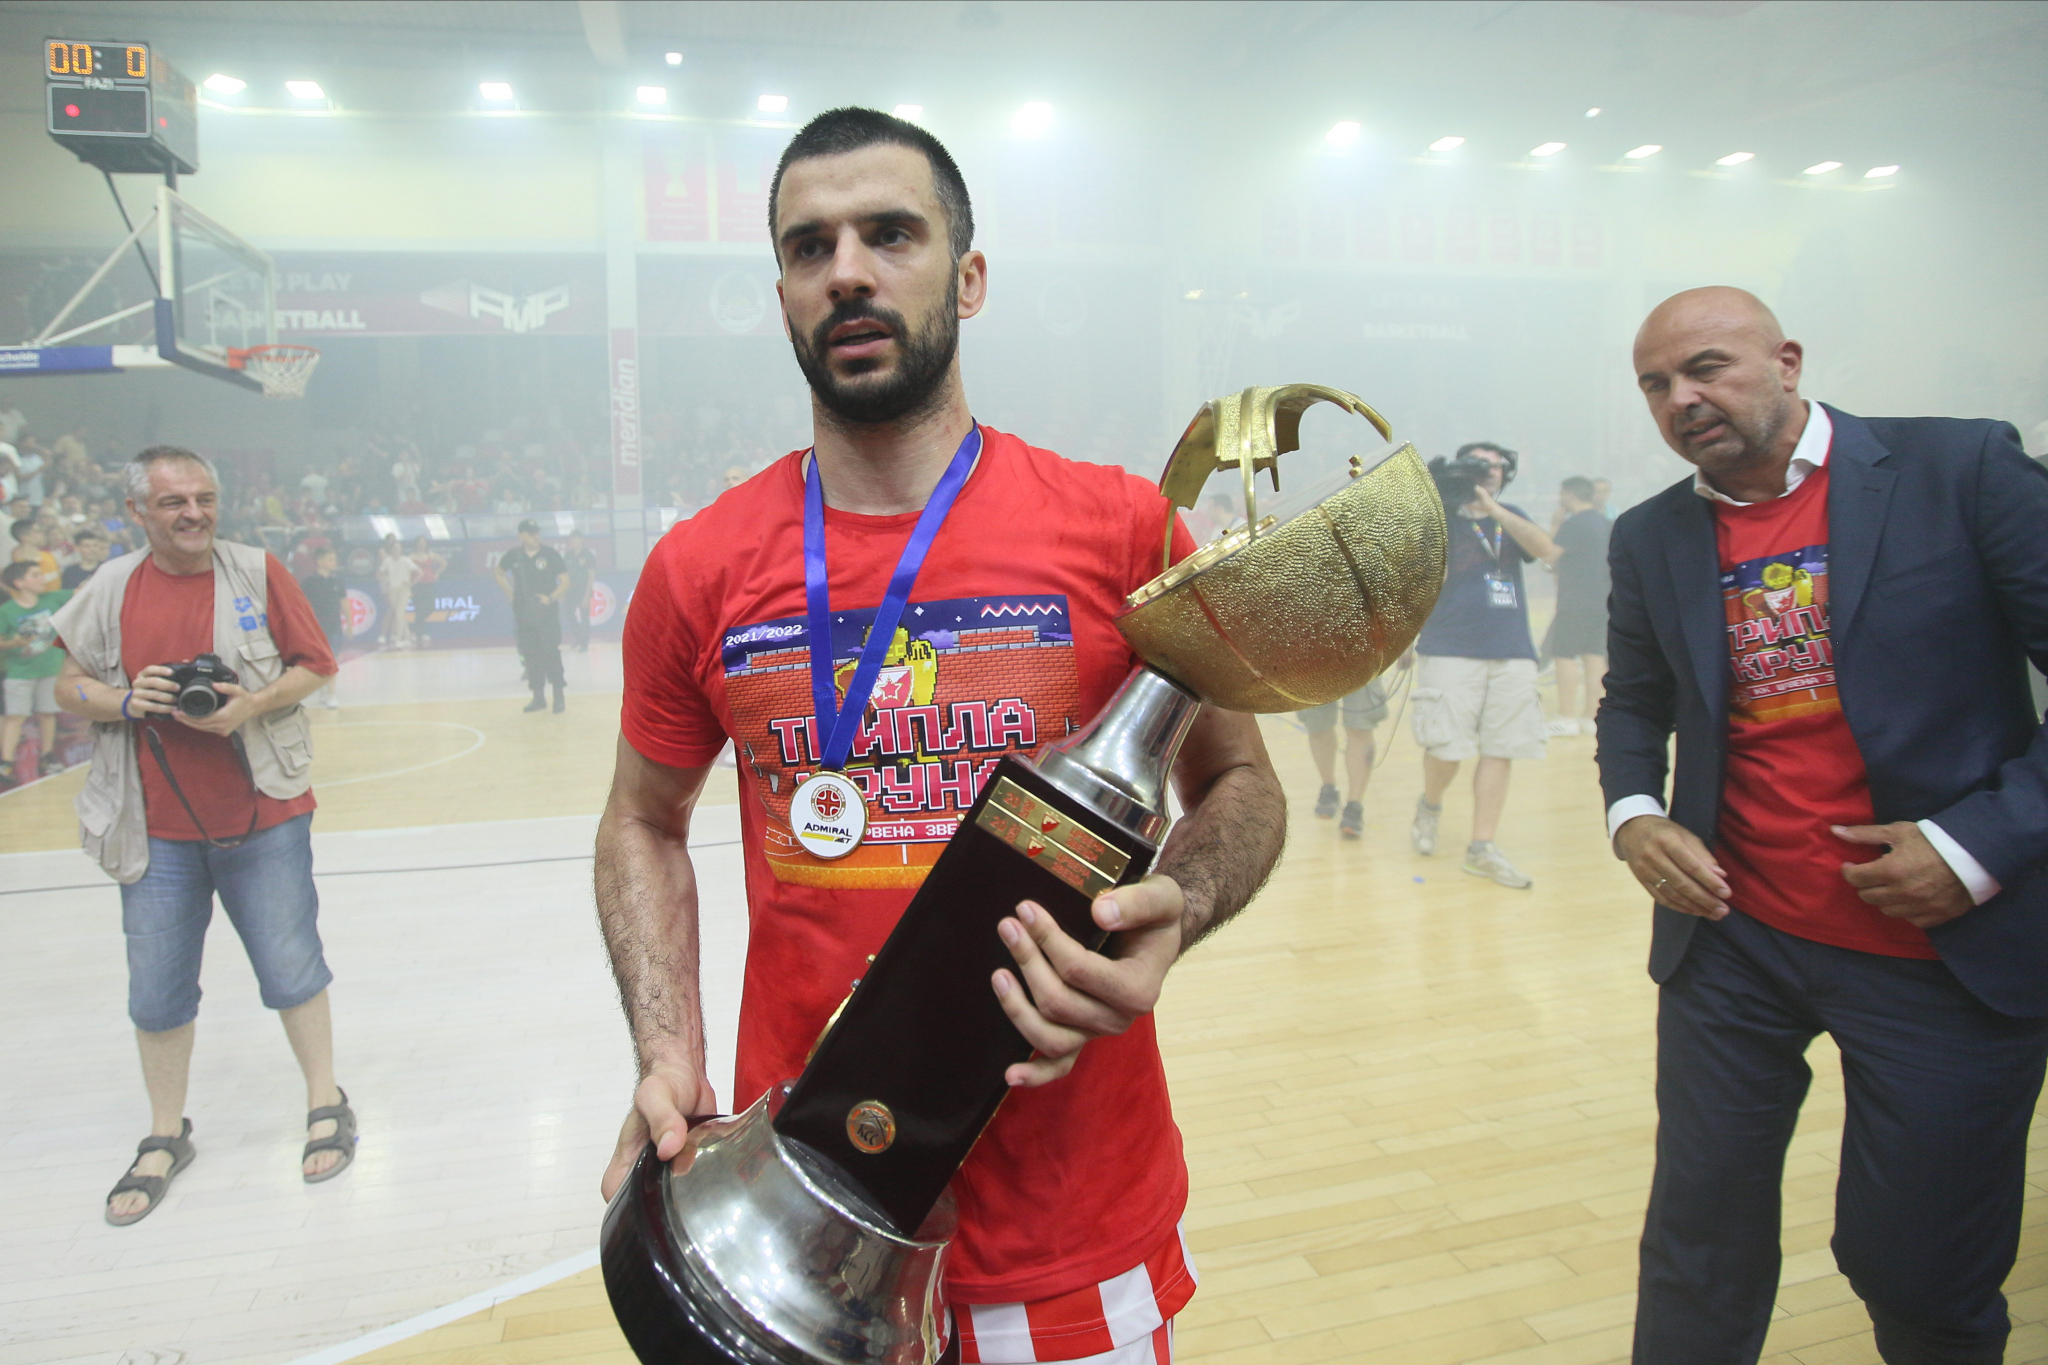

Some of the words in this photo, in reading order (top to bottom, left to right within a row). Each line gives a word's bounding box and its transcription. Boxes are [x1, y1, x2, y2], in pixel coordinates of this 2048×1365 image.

[126, 46, 147, 77] 0
[286, 272, 352, 291] PLAY
[612, 358, 637, 467] meridian
[725, 624, 803, 646] 2021/2022
[1727, 604, 1831, 651] РИП
[1003, 792, 1021, 809] 20
[804, 822, 853, 837] ADMIRAL
[925, 823, 958, 837] ЗВЕ
[989, 815, 1007, 832] 20
